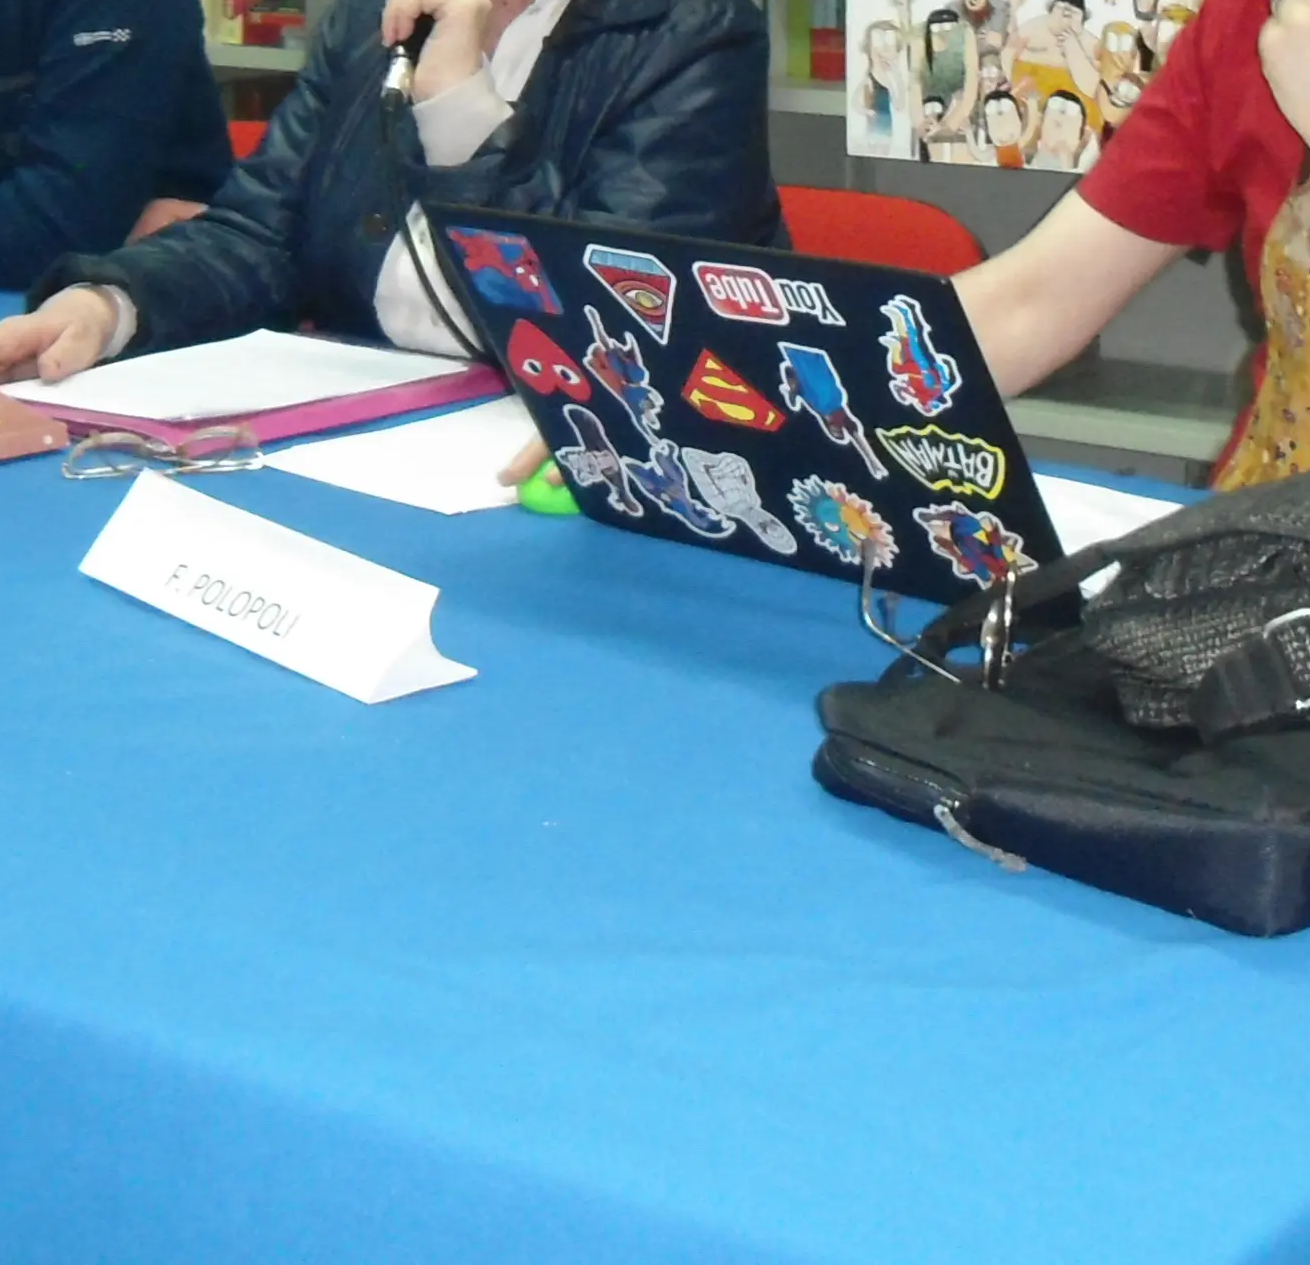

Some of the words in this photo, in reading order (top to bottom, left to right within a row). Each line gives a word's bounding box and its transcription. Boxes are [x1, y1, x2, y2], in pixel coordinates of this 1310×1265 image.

[704, 272, 842, 323] YouTube
[888, 436, 995, 488] BATMAN
[186, 573, 302, 640] POLOPOLI
